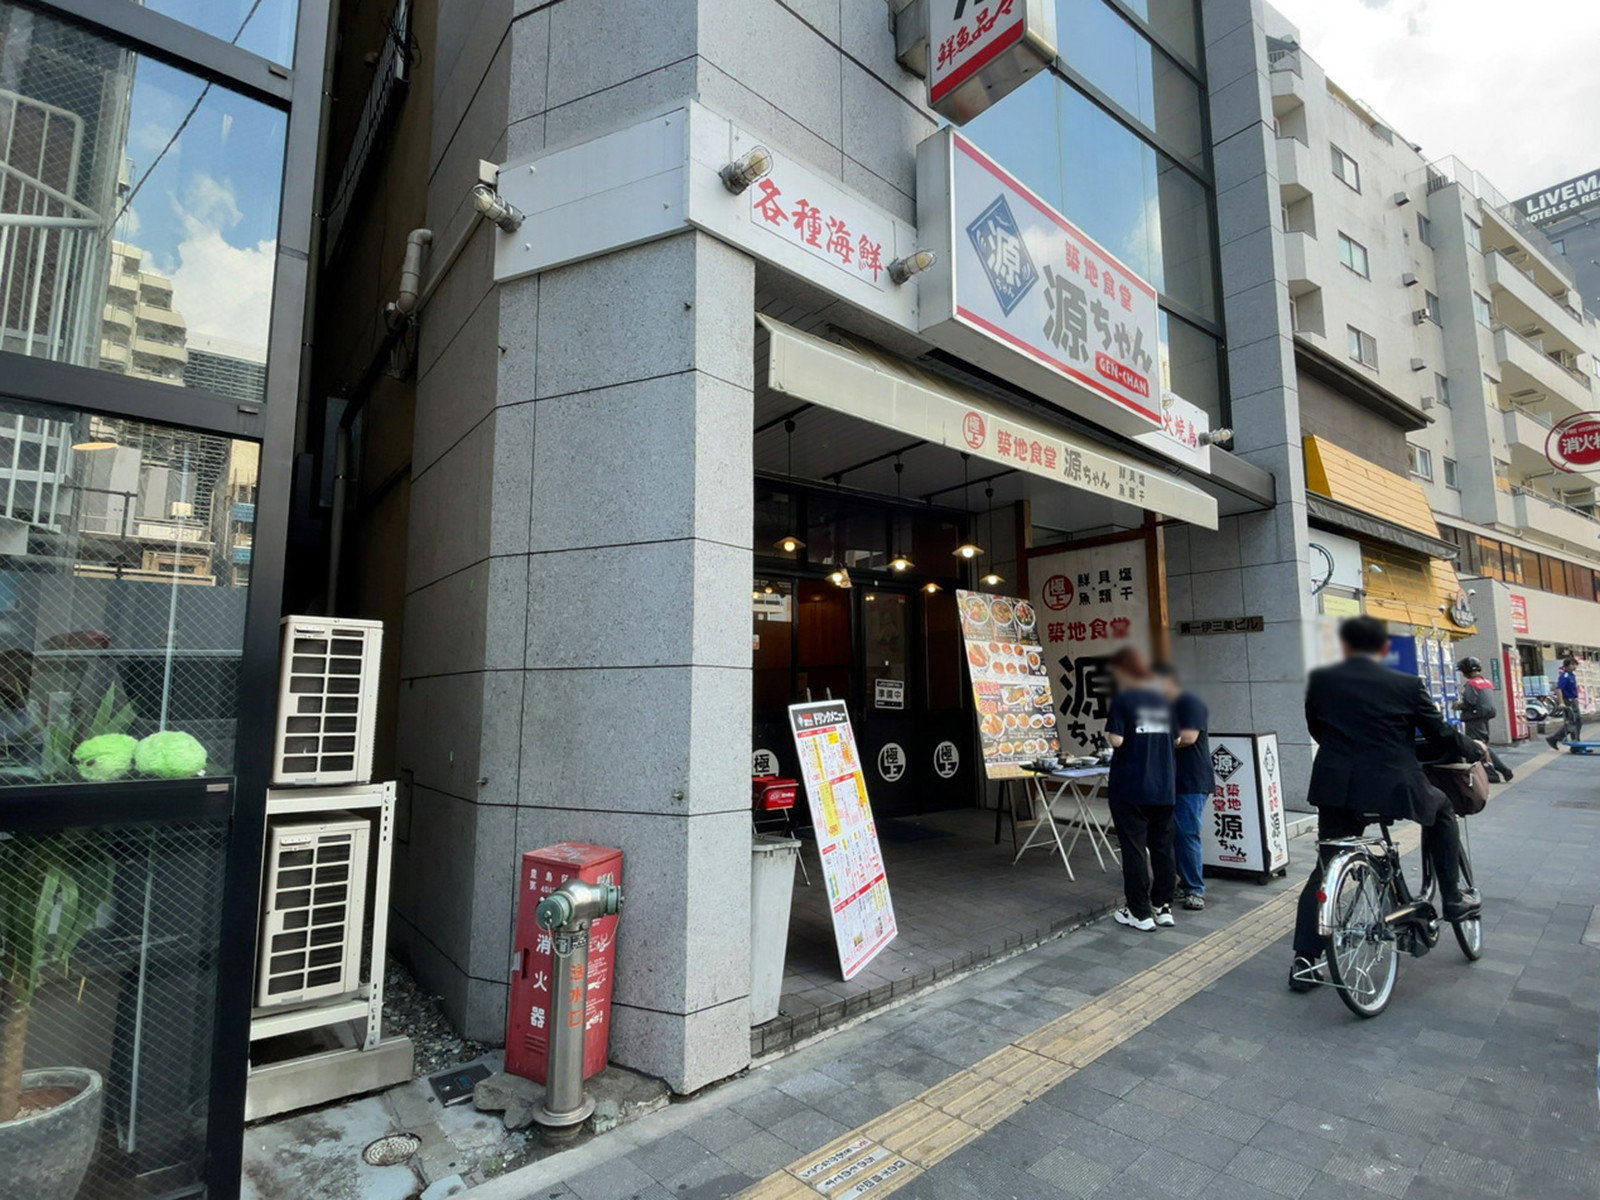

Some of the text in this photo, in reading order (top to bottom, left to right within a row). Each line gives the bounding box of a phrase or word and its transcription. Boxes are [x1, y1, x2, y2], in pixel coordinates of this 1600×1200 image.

[753, 178, 884, 283] 各種海鮮
[987, 219, 1021, 288] 源
[1066, 240, 1133, 312] 築地食堂
[1043, 264, 1152, 373] 源ちゃん
[1099, 358, 1147, 396] GEN-CHAN
[997, 429, 1057, 470] 築地食堂
[1064, 447, 1109, 490] 源ちゃん
[1047, 616, 1131, 643] 築地食堂
[883, 746, 902, 778] 極上
[939, 743, 956, 776] 極上
[530, 934, 551, 1029] 消火器
